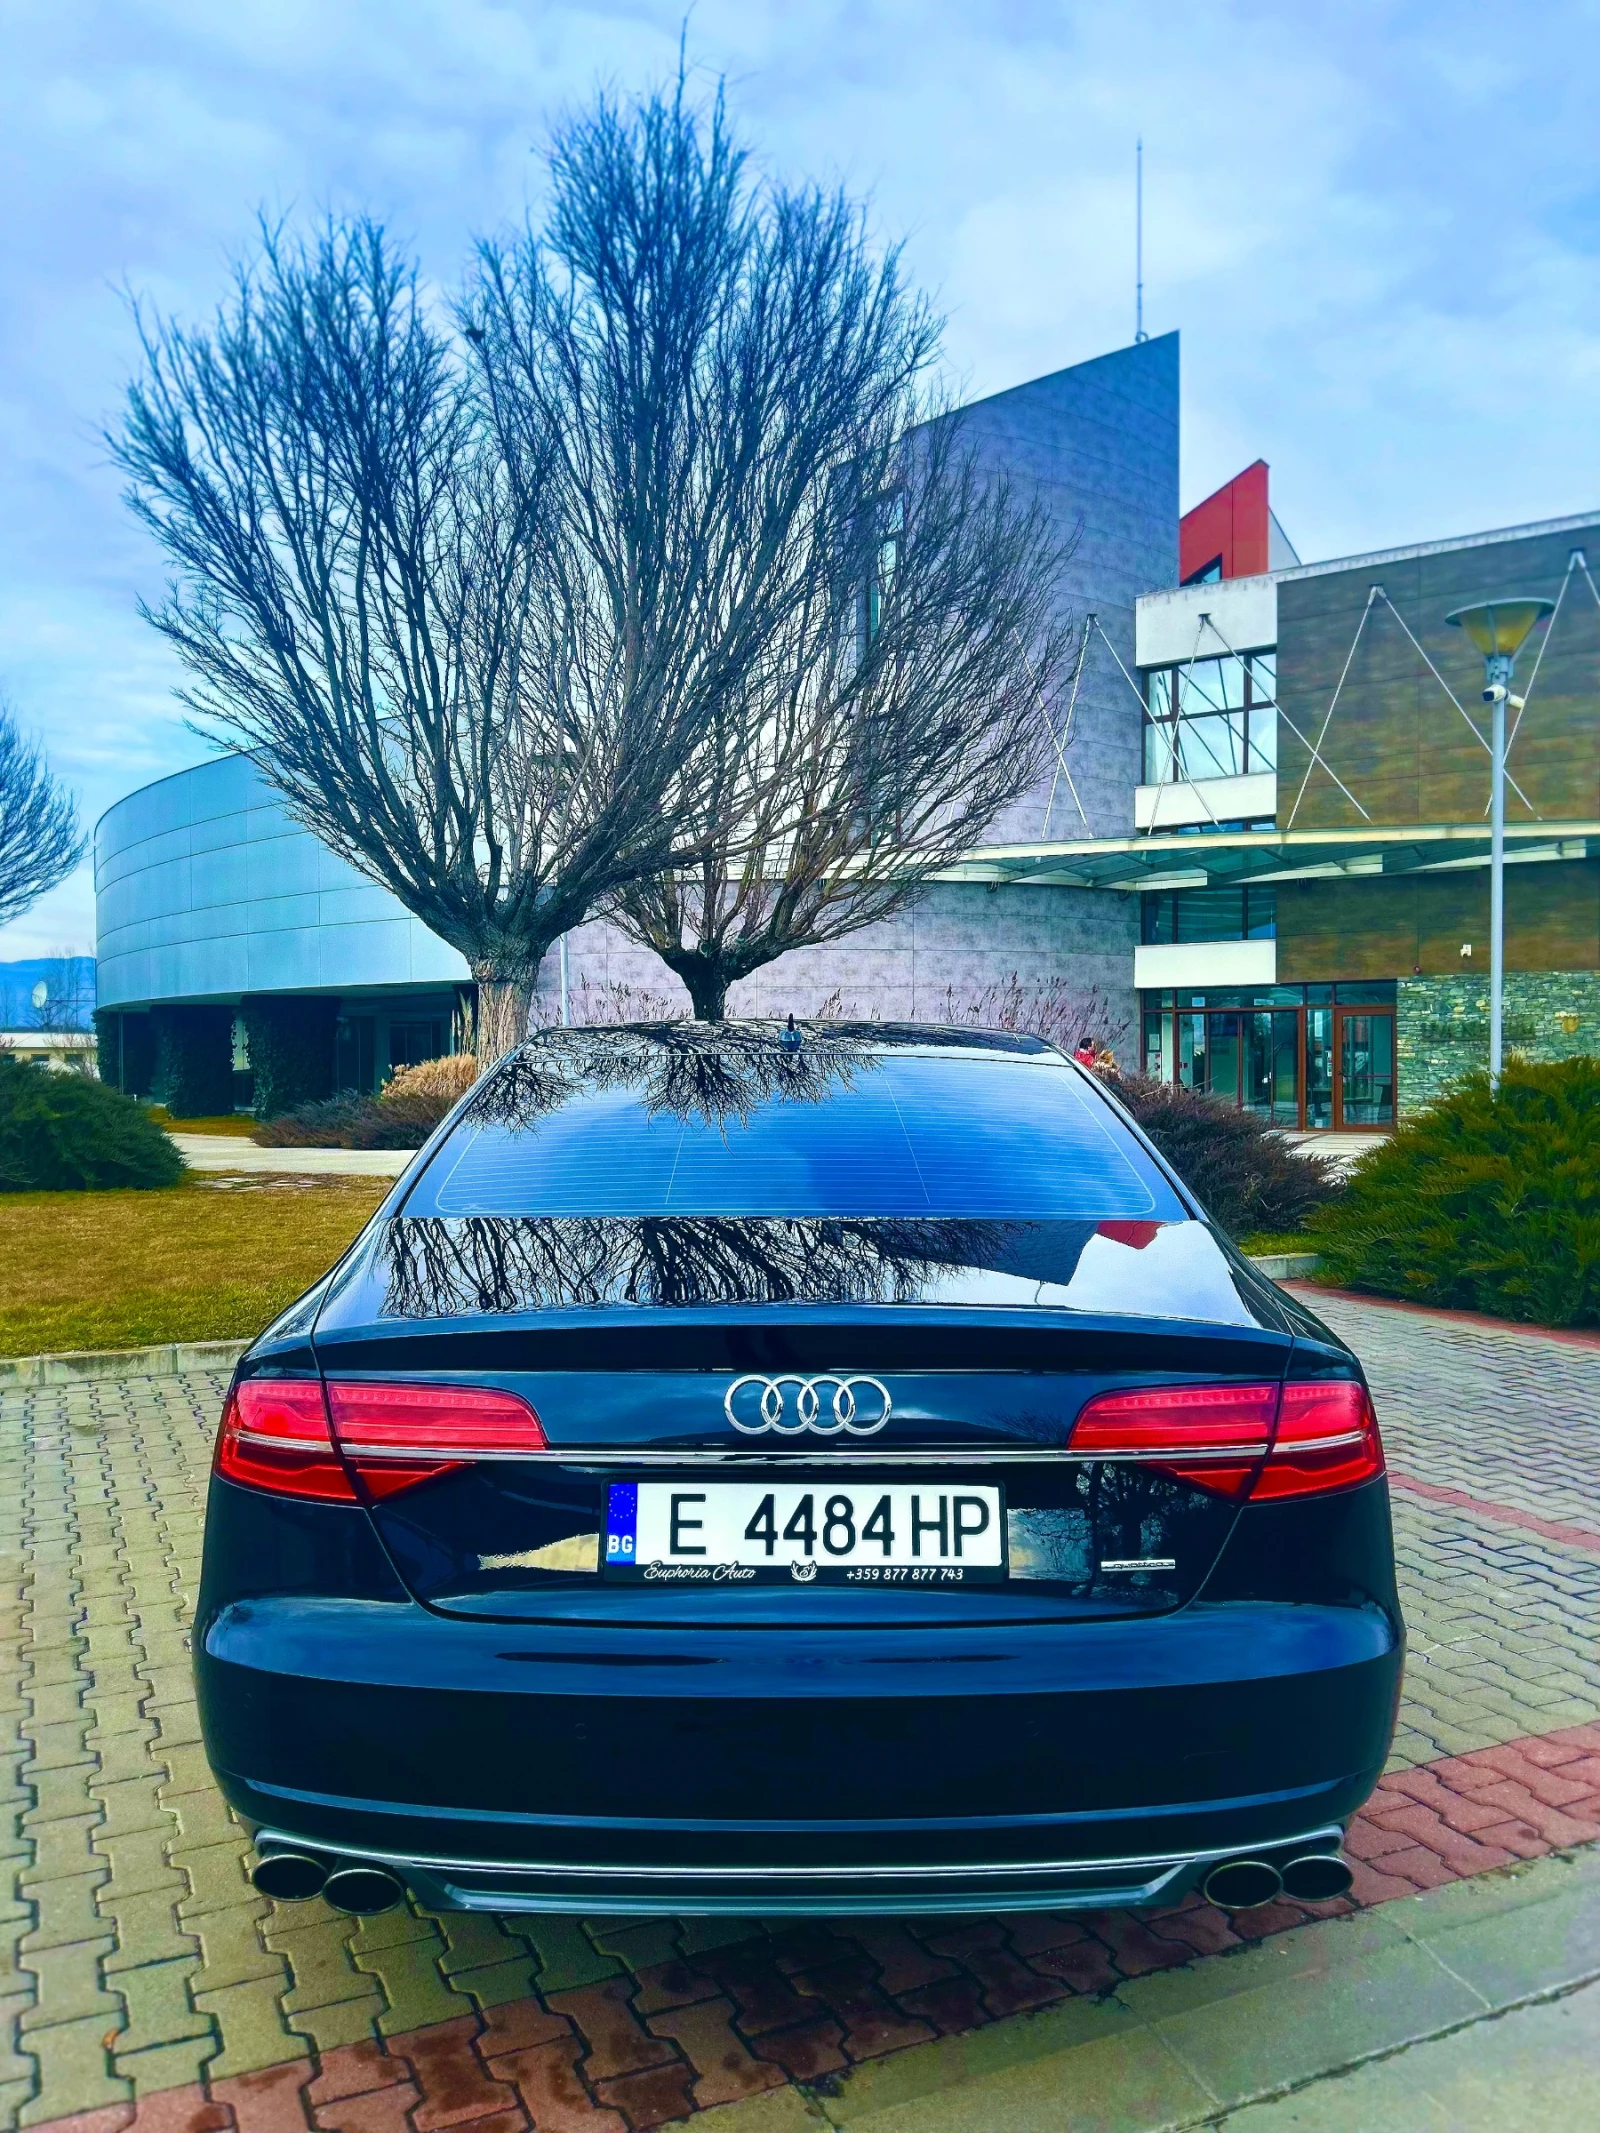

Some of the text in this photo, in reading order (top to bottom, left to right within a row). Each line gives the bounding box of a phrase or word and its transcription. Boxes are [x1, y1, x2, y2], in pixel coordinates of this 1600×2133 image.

[670, 1493, 990, 1557] E 4484 HP
[608, 1535, 633, 1553] BG
[643, 1561, 757, 1581] Euphoria Auto
[846, 1568, 964, 1581] +359 877 877 743
